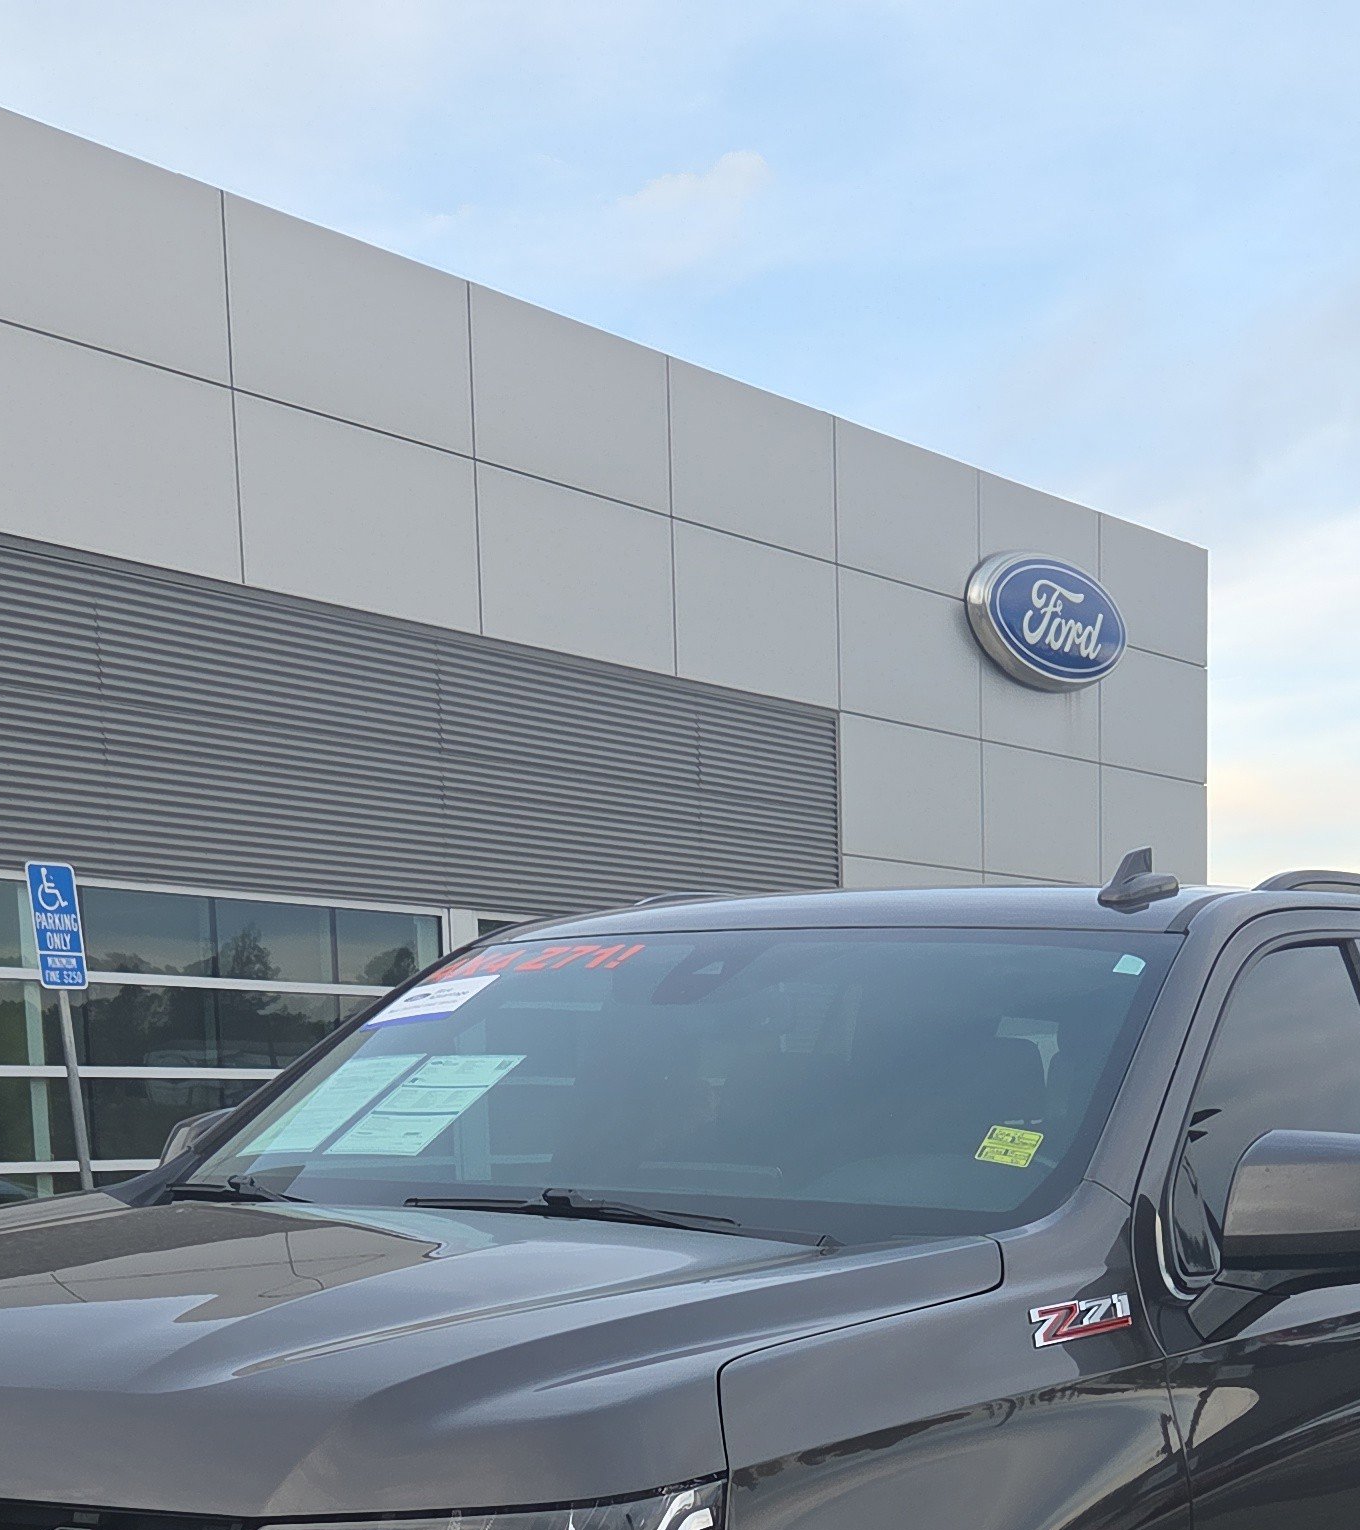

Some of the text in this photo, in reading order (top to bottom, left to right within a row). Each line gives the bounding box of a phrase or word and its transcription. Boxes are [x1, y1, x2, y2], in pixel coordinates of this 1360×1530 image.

[1023, 579, 1101, 660] Ford
[35, 912, 78, 931] PARKING
[46, 932, 71, 950] ONLY
[45, 970, 60, 982] FINE
[1029, 1292, 1132, 1347] Z71
